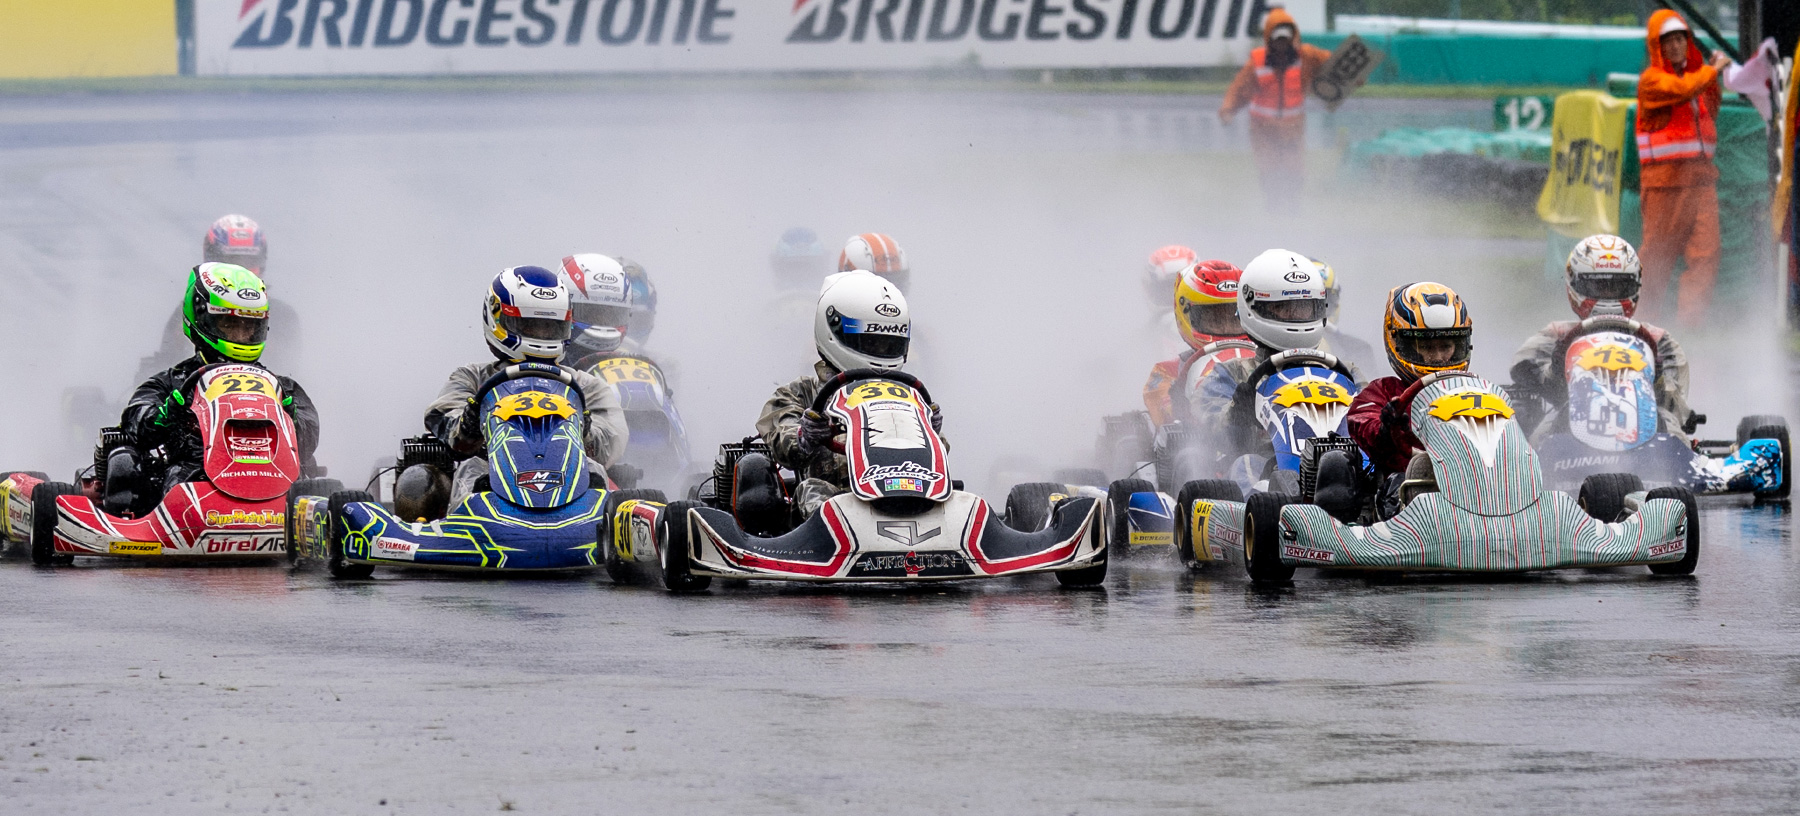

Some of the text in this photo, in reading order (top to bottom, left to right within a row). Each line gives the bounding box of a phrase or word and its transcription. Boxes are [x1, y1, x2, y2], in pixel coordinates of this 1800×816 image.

[230, 0, 736, 48] BRIDGESTONE
[1503, 96, 1545, 131] 12
[598, 273, 616, 282] Arai
[1290, 271, 1308, 281] Arai
[1220, 280, 1239, 289] Arai
[242, 288, 260, 298] Arai
[536, 288, 555, 297] Arai
[879, 303, 898, 314] Arai
[1593, 350, 1632, 364] 73
[610, 368, 651, 380] 16
[222, 378, 265, 395] 22
[860, 386, 909, 399] 30
[1297, 384, 1340, 399] 18
[514, 397, 559, 412] 36
[1460, 394, 1483, 408] 7
[1553, 455, 1620, 472] FUJINAMI
[220, 470, 284, 479] RICHARD MILLE
[206, 537, 287, 553] birelAR
[385, 541, 412, 551] YAMAHA
[1284, 545, 1332, 561] TONY KART
